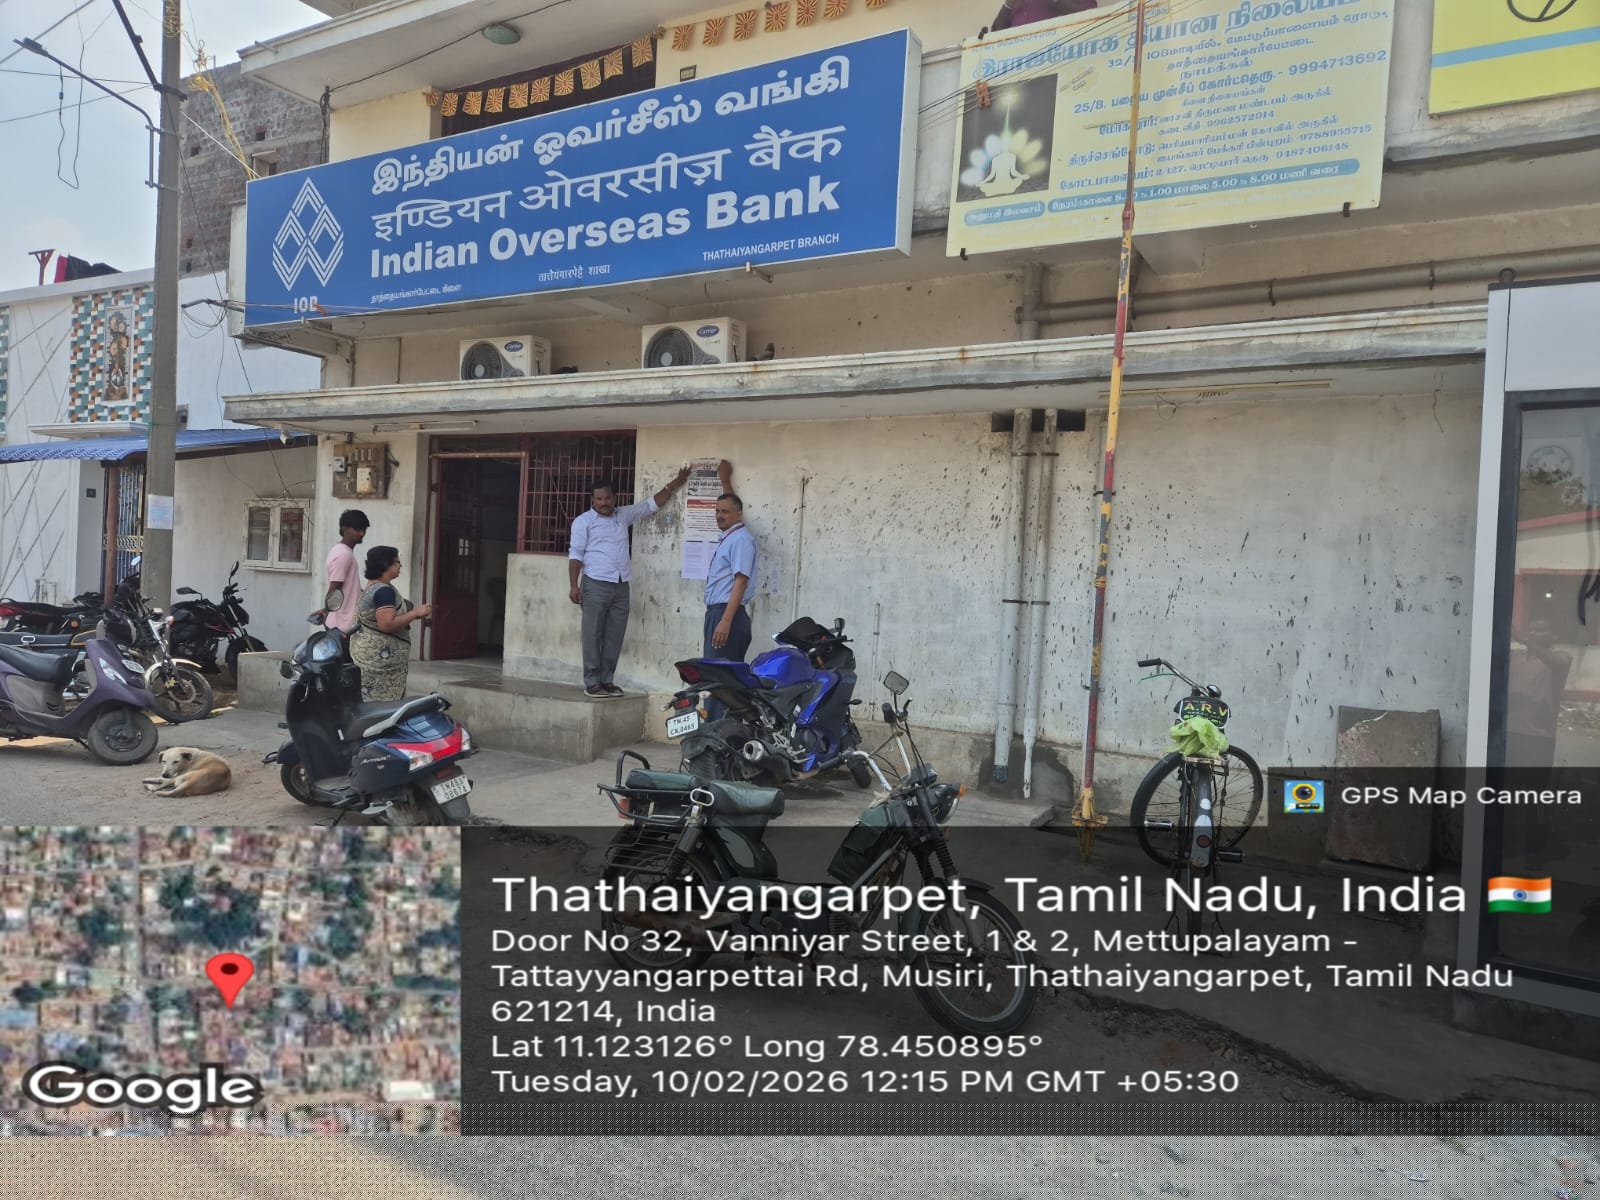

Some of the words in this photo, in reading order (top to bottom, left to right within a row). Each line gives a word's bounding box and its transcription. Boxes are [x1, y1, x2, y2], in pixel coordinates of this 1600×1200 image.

[371, 133, 524, 196] இந்தியன்
[532, 94, 702, 167] ஓவர்சீஸ்
[714, 55, 850, 116] வங்கி
[371, 188, 522, 242] इण्डियन
[518, 147, 732, 215] ओवरसीज़
[743, 125, 846, 172] बैंक
[371, 240, 478, 279] Indian
[489, 207, 691, 262] Overseas
[706, 175, 841, 230] Bank
[702, 239, 796, 261] THATHAIYANGARPET
[797, 232, 840, 249] BRANCH
